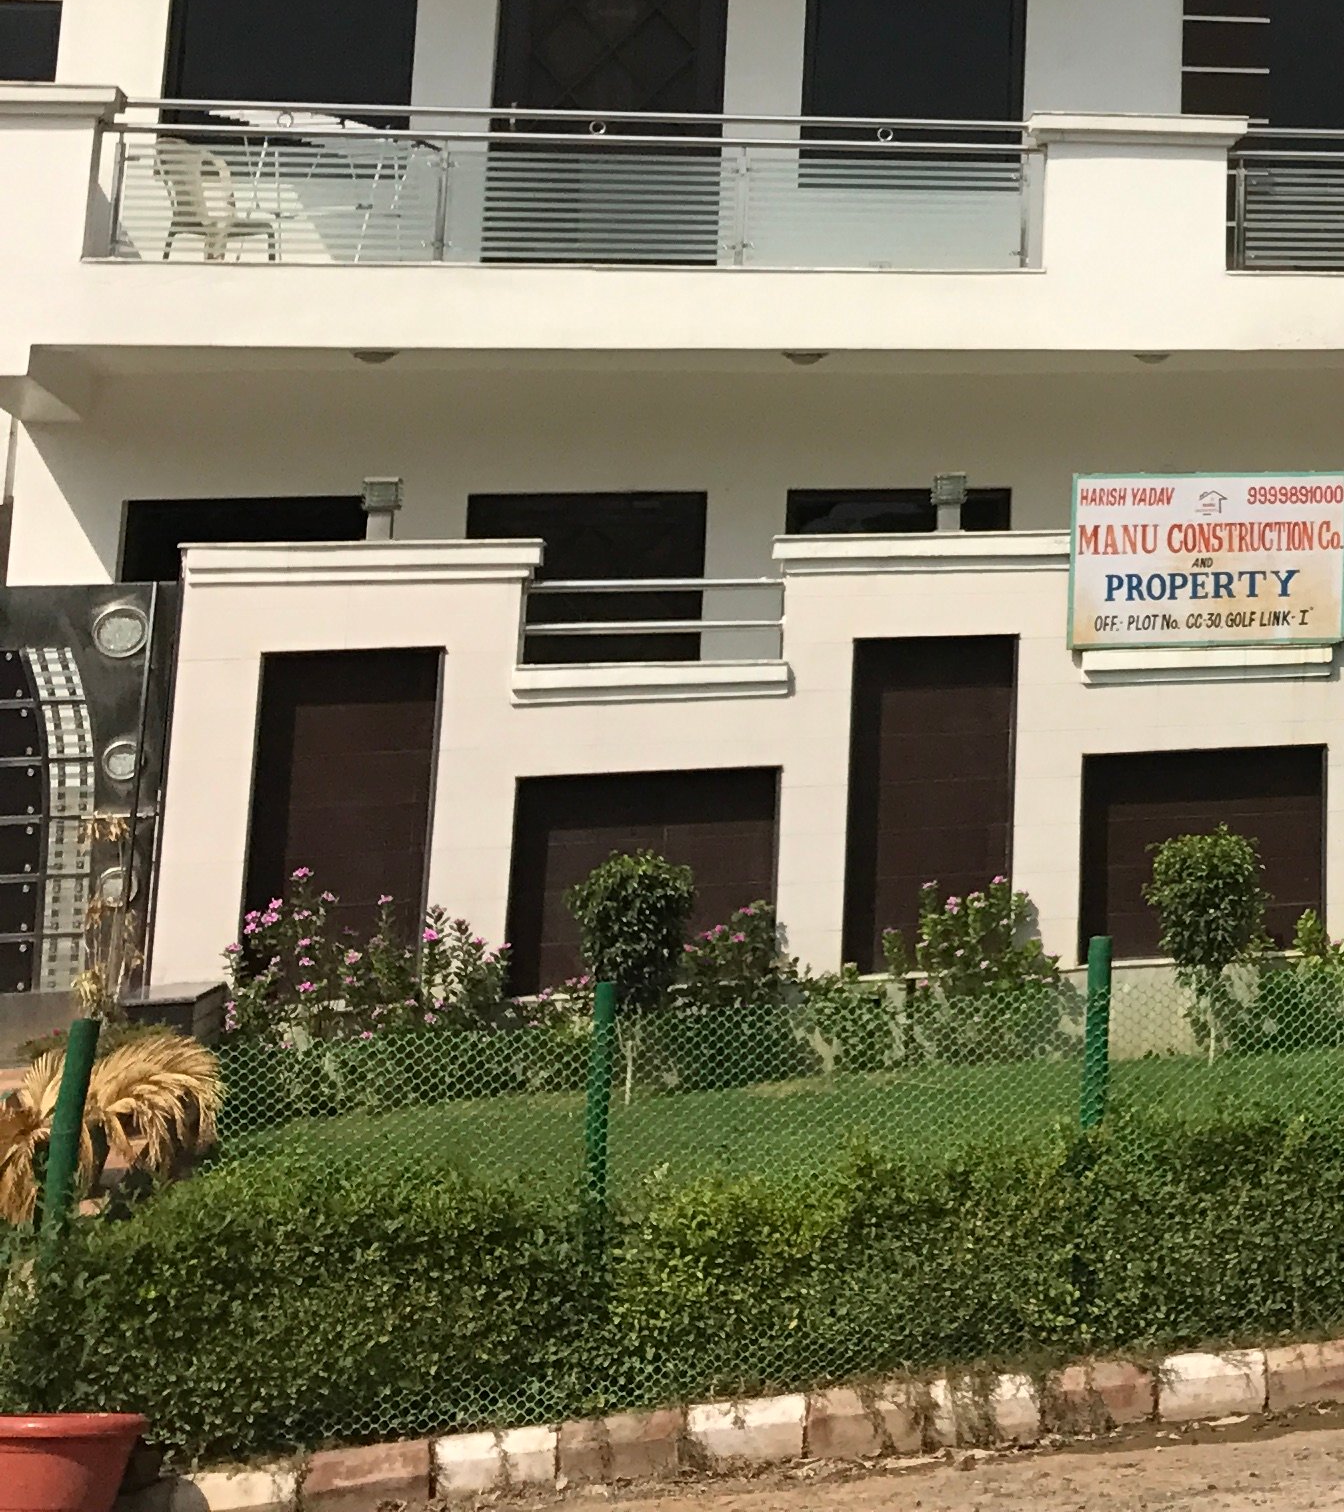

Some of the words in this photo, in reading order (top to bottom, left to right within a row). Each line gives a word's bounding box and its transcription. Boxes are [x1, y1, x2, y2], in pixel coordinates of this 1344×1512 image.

[1080, 488, 1127, 506] HARISH
[1131, 487, 1175, 506] YADAV
[1247, 485, 1344, 505] 9999891000
[1078, 524, 1159, 555] MANU
[1167, 521, 1314, 553] CONSTRUCTION
[1192, 557, 1213, 568] AND
[1104, 569, 1300, 602] PROPERTY
[1127, 614, 1159, 631] PLOT
[1225, 611, 1256, 628] GOLF
